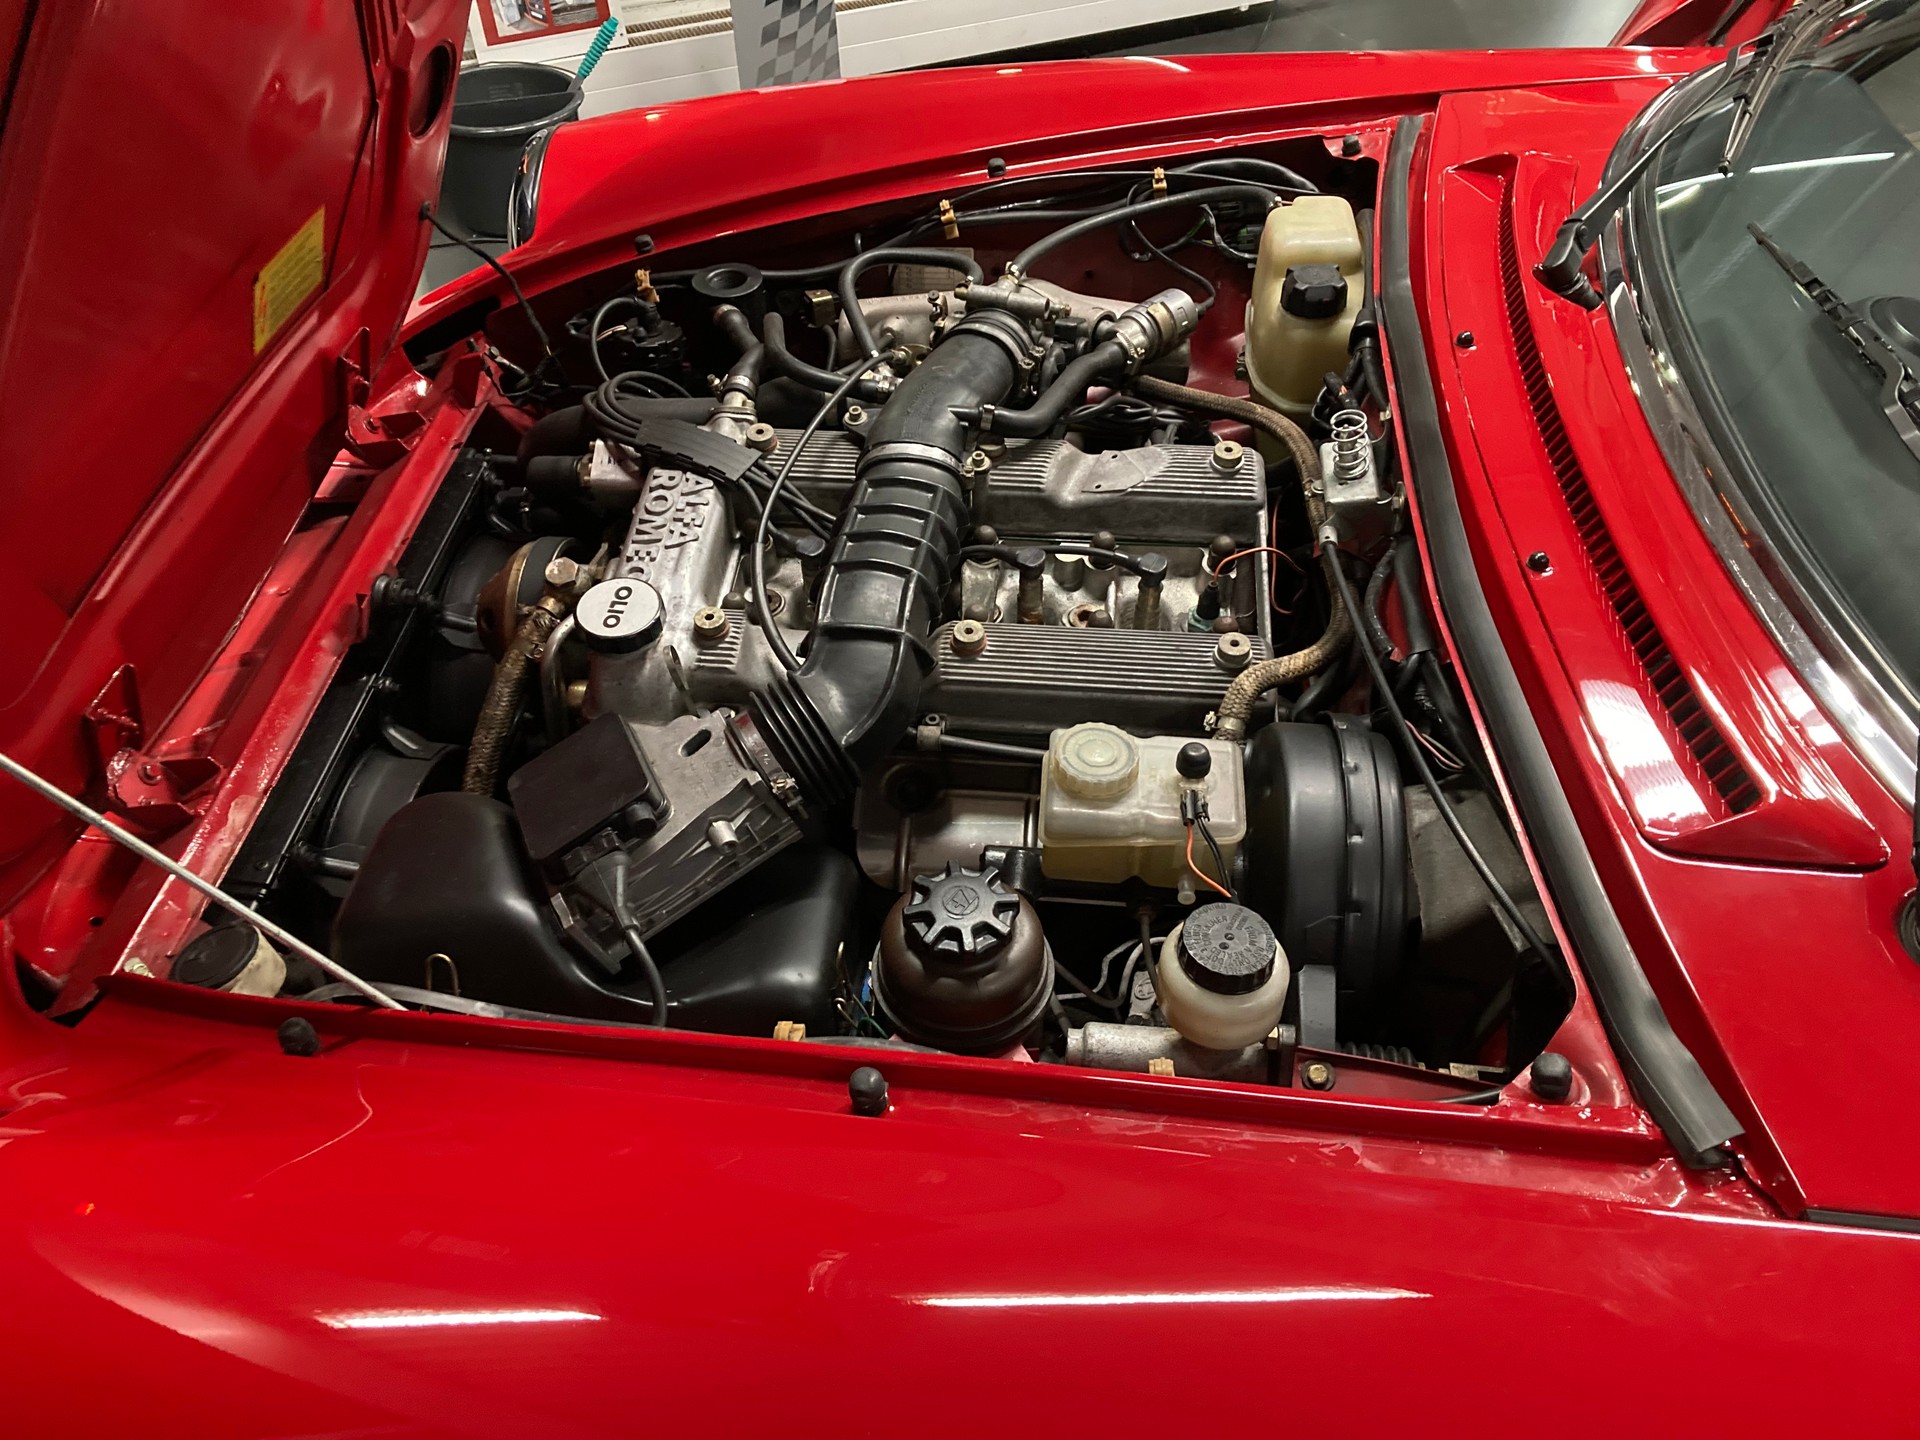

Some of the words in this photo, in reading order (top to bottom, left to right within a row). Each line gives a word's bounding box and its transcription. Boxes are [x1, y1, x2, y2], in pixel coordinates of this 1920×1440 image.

[622, 469, 683, 582] ROMEO
[664, 471, 714, 549] ALFA
[602, 586, 633, 629] OLIO
[1244, 925, 1257, 946] FROM
